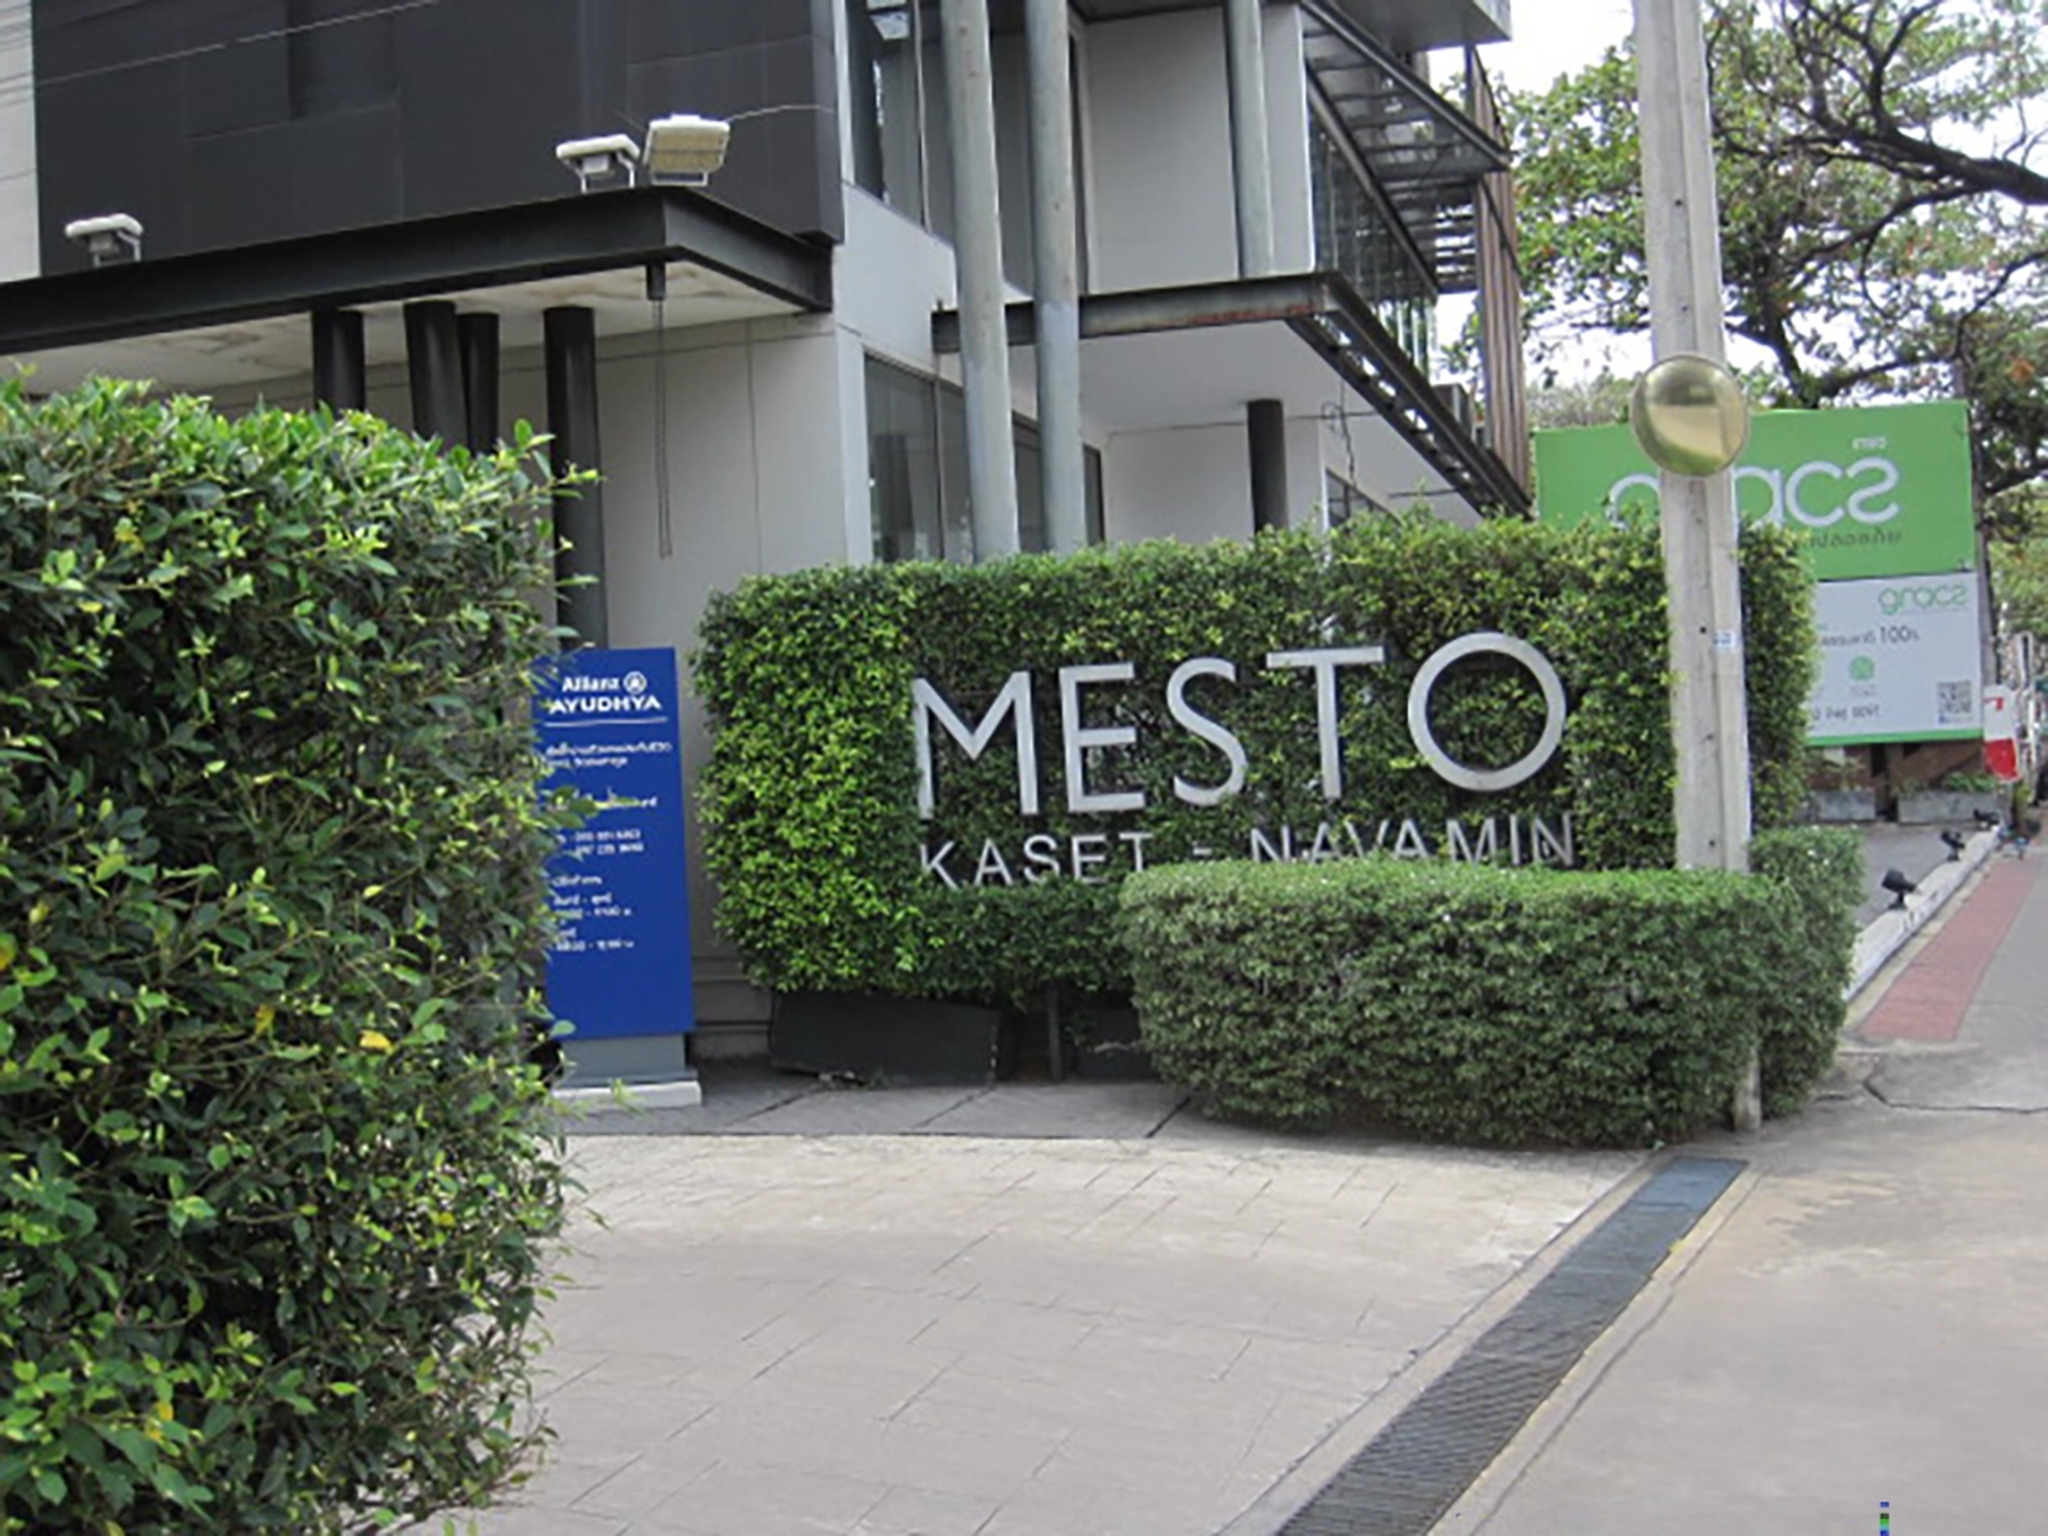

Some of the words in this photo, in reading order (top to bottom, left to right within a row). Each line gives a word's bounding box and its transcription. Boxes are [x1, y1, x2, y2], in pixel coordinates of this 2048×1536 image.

[548, 694, 662, 714] AYUDHYA
[562, 676, 620, 692] Allianz
[911, 631, 1567, 819] MESTO
[920, 832, 1153, 889] KASET
[1251, 813, 1575, 868] NAVAMIN
